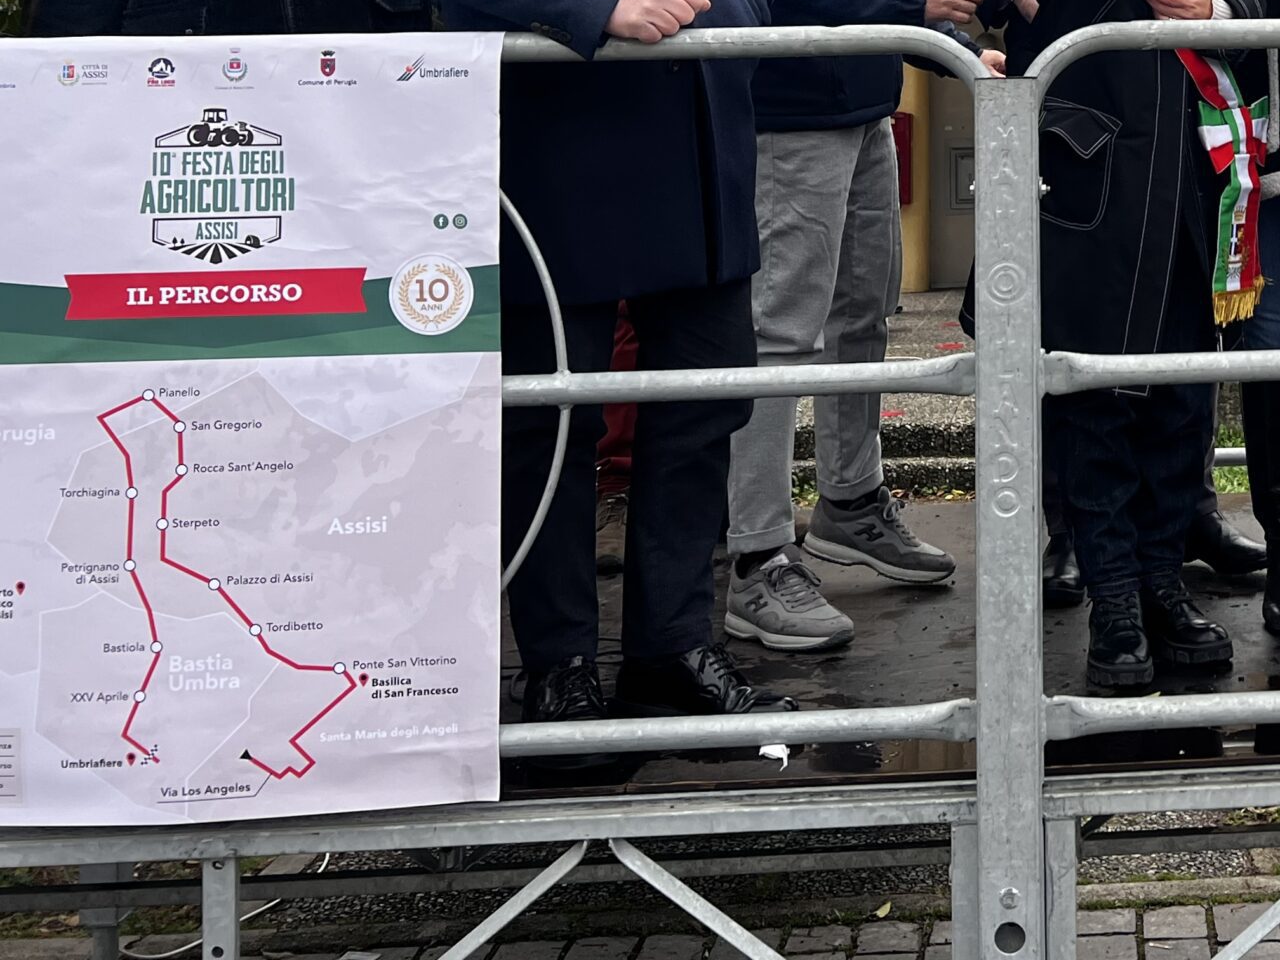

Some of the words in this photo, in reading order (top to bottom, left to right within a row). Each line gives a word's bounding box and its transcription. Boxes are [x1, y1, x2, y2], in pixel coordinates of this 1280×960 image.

[82, 71, 108, 79] ASSISI
[419, 67, 469, 78] Umbriafiere
[326, 78, 332, 86] di
[181, 151, 234, 176] FESTA
[238, 149, 284, 175] DEGLI
[139, 177, 295, 214] AGRICOLTORI
[195, 222, 238, 240] ASSISI
[126, 288, 153, 305] IL
[159, 284, 302, 304] PERCORSO
[415, 278, 449, 303] 10
[420, 304, 443, 313] ANNI
[158, 387, 201, 398] Pianello
[191, 420, 212, 431] San
[215, 418, 263, 433] Gregorio
[193, 463, 225, 473] Rocca
[228, 460, 294, 473] Sant'Angelo
[59, 487, 121, 501] Torchiagina
[172, 516, 220, 531] Sterpeto
[327, 515, 388, 535] Assisi
[60, 561, 120, 575] Petrignano
[75, 573, 86, 585] di
[87, 572, 120, 584] Assisi
[226, 574, 267, 586] Palazzo
[269, 573, 280, 584] di
[283, 571, 313, 584] Assisi
[266, 620, 324, 633] Tordibetto
[103, 641, 145, 653] Bastiola
[168, 654, 234, 672] Bastia
[353, 659, 384, 671] Ponte
[387, 658, 407, 669] San
[410, 655, 457, 668] Vittorino
[168, 672, 241, 692] Umbra
[371, 675, 412, 686] Basilica
[71, 692, 93, 703] XXV
[97, 690, 129, 706] Aprile
[371, 687, 382, 699] di
[383, 686, 404, 698] San
[405, 683, 459, 696] Francesco
[319, 730, 354, 743] Santa
[355, 728, 386, 742] Maria
[388, 727, 418, 743] degli
[420, 723, 459, 739] Angeli
[60, 757, 123, 769] Umbriafiere
[160, 786, 178, 798] Via
[180, 786, 201, 797] Los
[203, 783, 251, 798] Angeles
